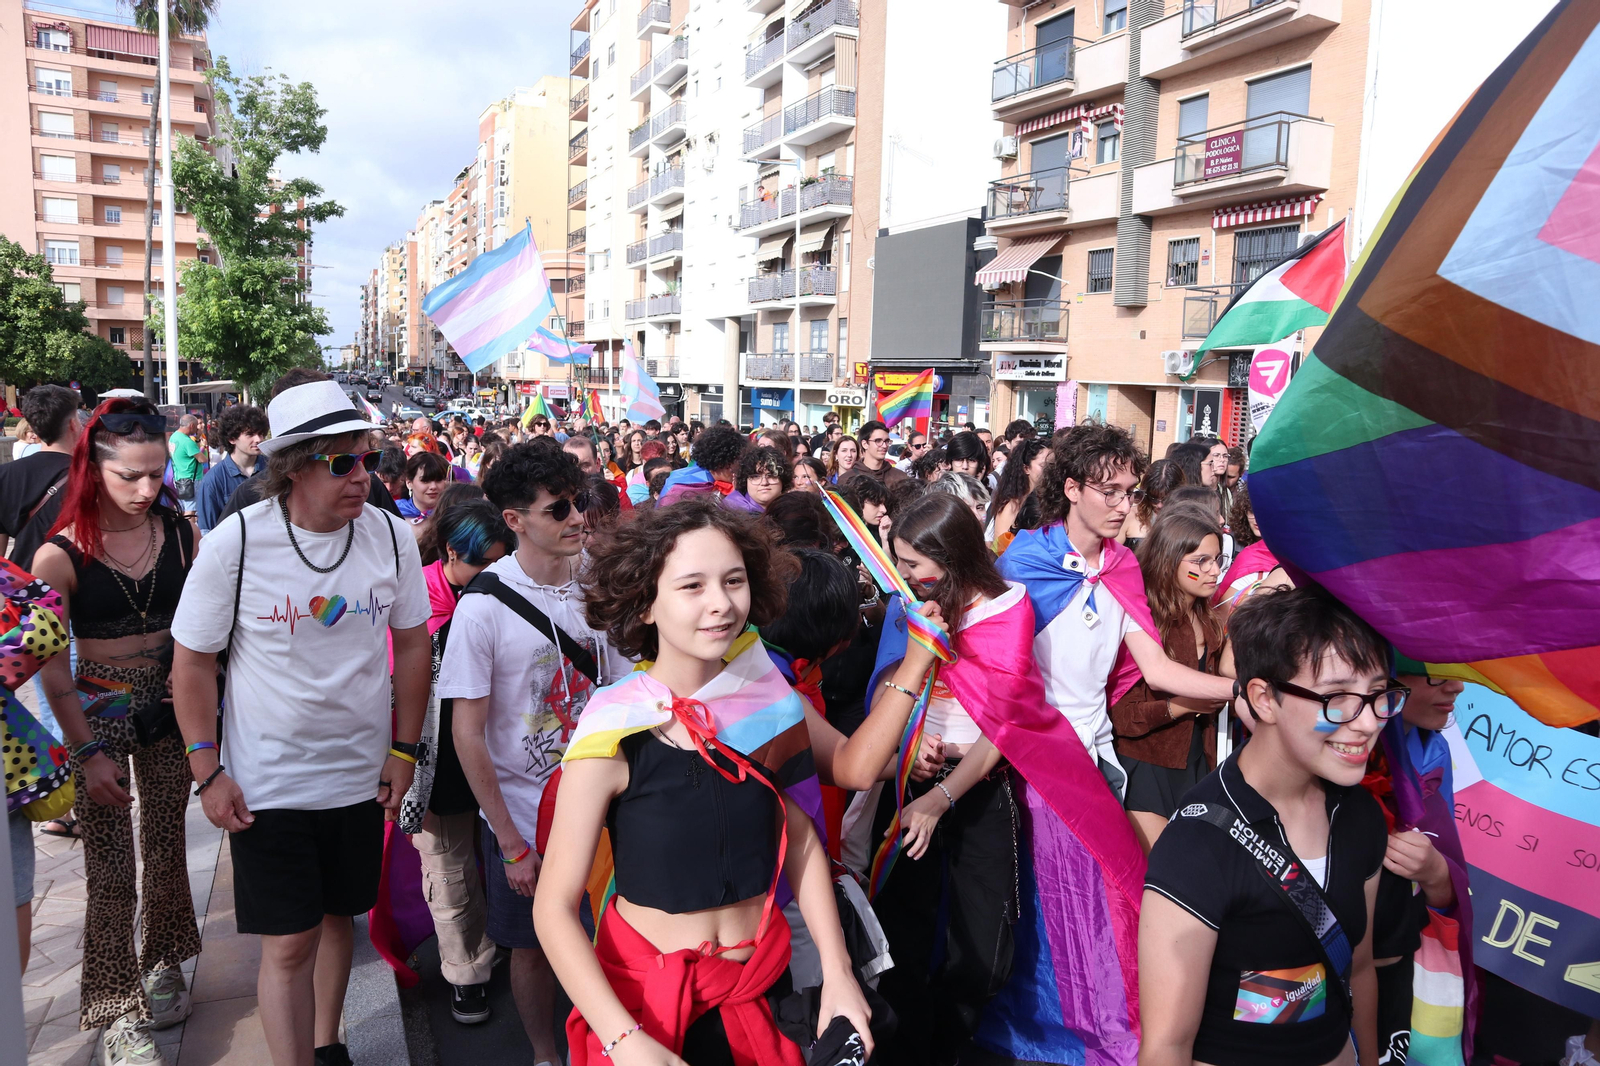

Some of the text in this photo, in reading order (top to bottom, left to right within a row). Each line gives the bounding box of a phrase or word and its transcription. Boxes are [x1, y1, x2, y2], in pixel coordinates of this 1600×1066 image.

[827, 394, 863, 405] ORO
[97, 688, 126, 700] igualdad
[1229, 827, 1280, 875] LIMITED
[1233, 818, 1285, 868] EDITION
[1454, 803, 1600, 872] ENOS SI SO
[1481, 898, 1560, 967] DE
[1285, 971, 1322, 1002] igualdad
